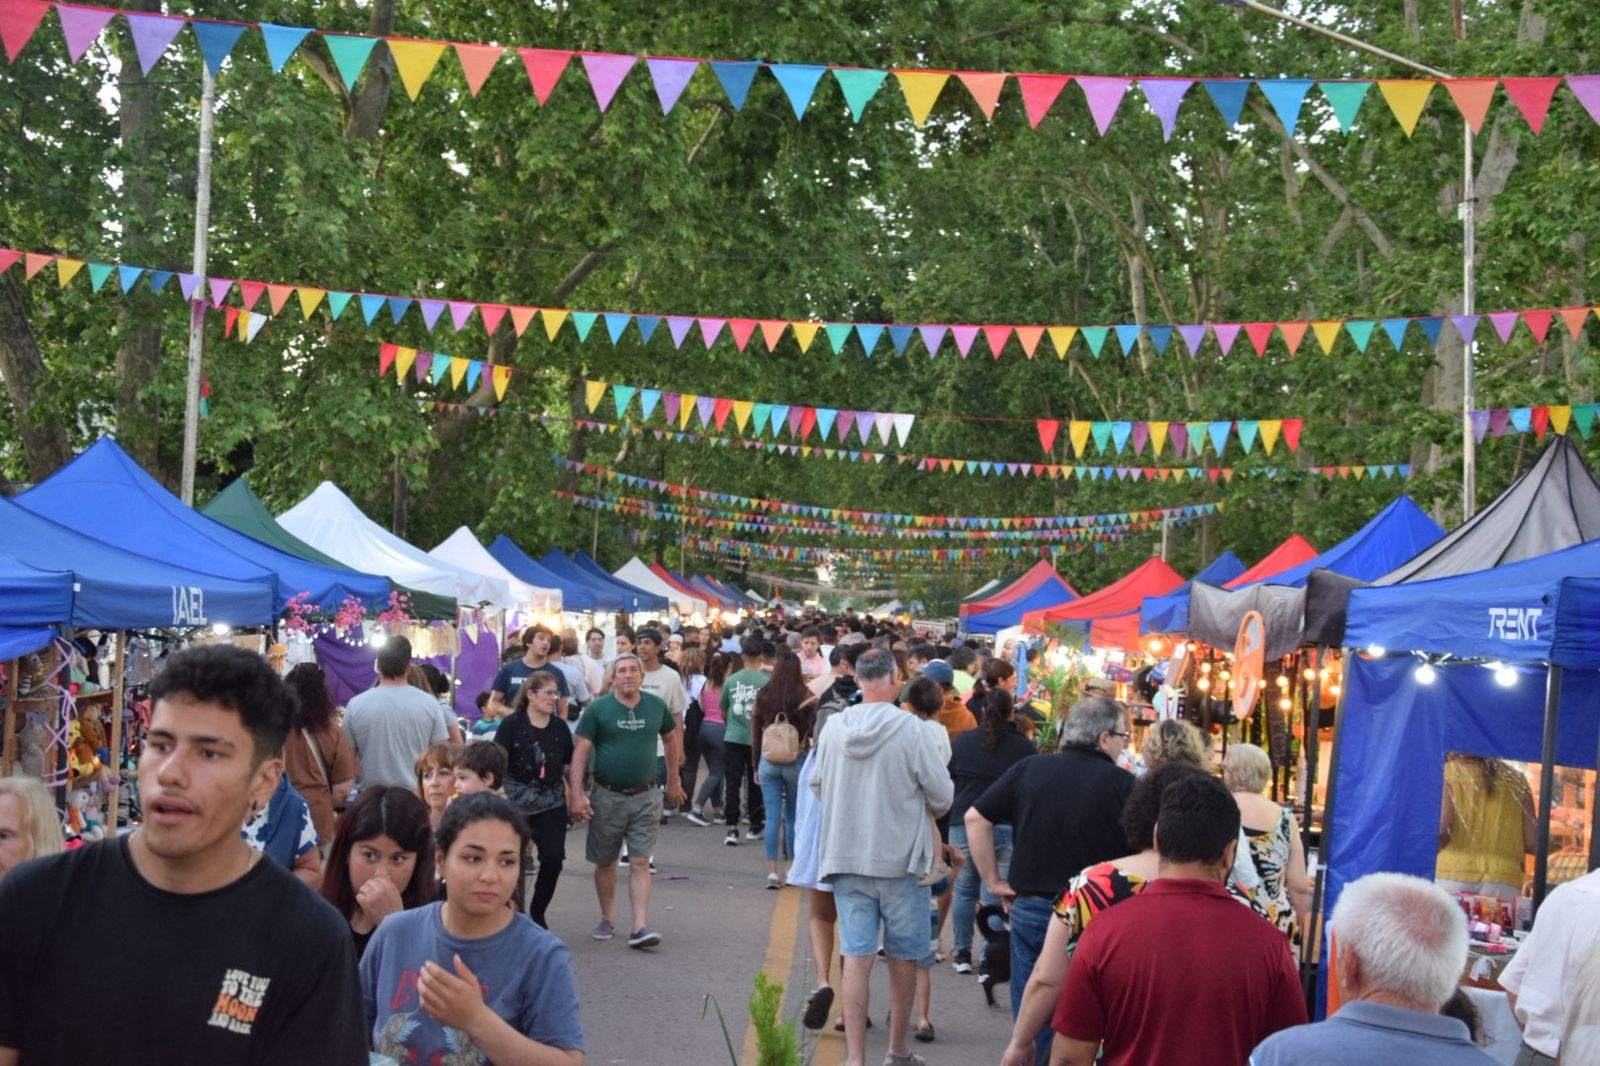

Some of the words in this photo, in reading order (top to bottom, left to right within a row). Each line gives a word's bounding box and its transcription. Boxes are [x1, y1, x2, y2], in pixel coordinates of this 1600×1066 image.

[1488, 607, 1542, 640] RENT
[221, 979, 239, 996] TO
[239, 985, 265, 1008] THE
[225, 968, 250, 987] LOVE
[250, 975, 271, 992] YOU
[212, 992, 258, 1023] MOON
[207, 1011, 230, 1028] AND
[228, 1017, 252, 1035] BACK
